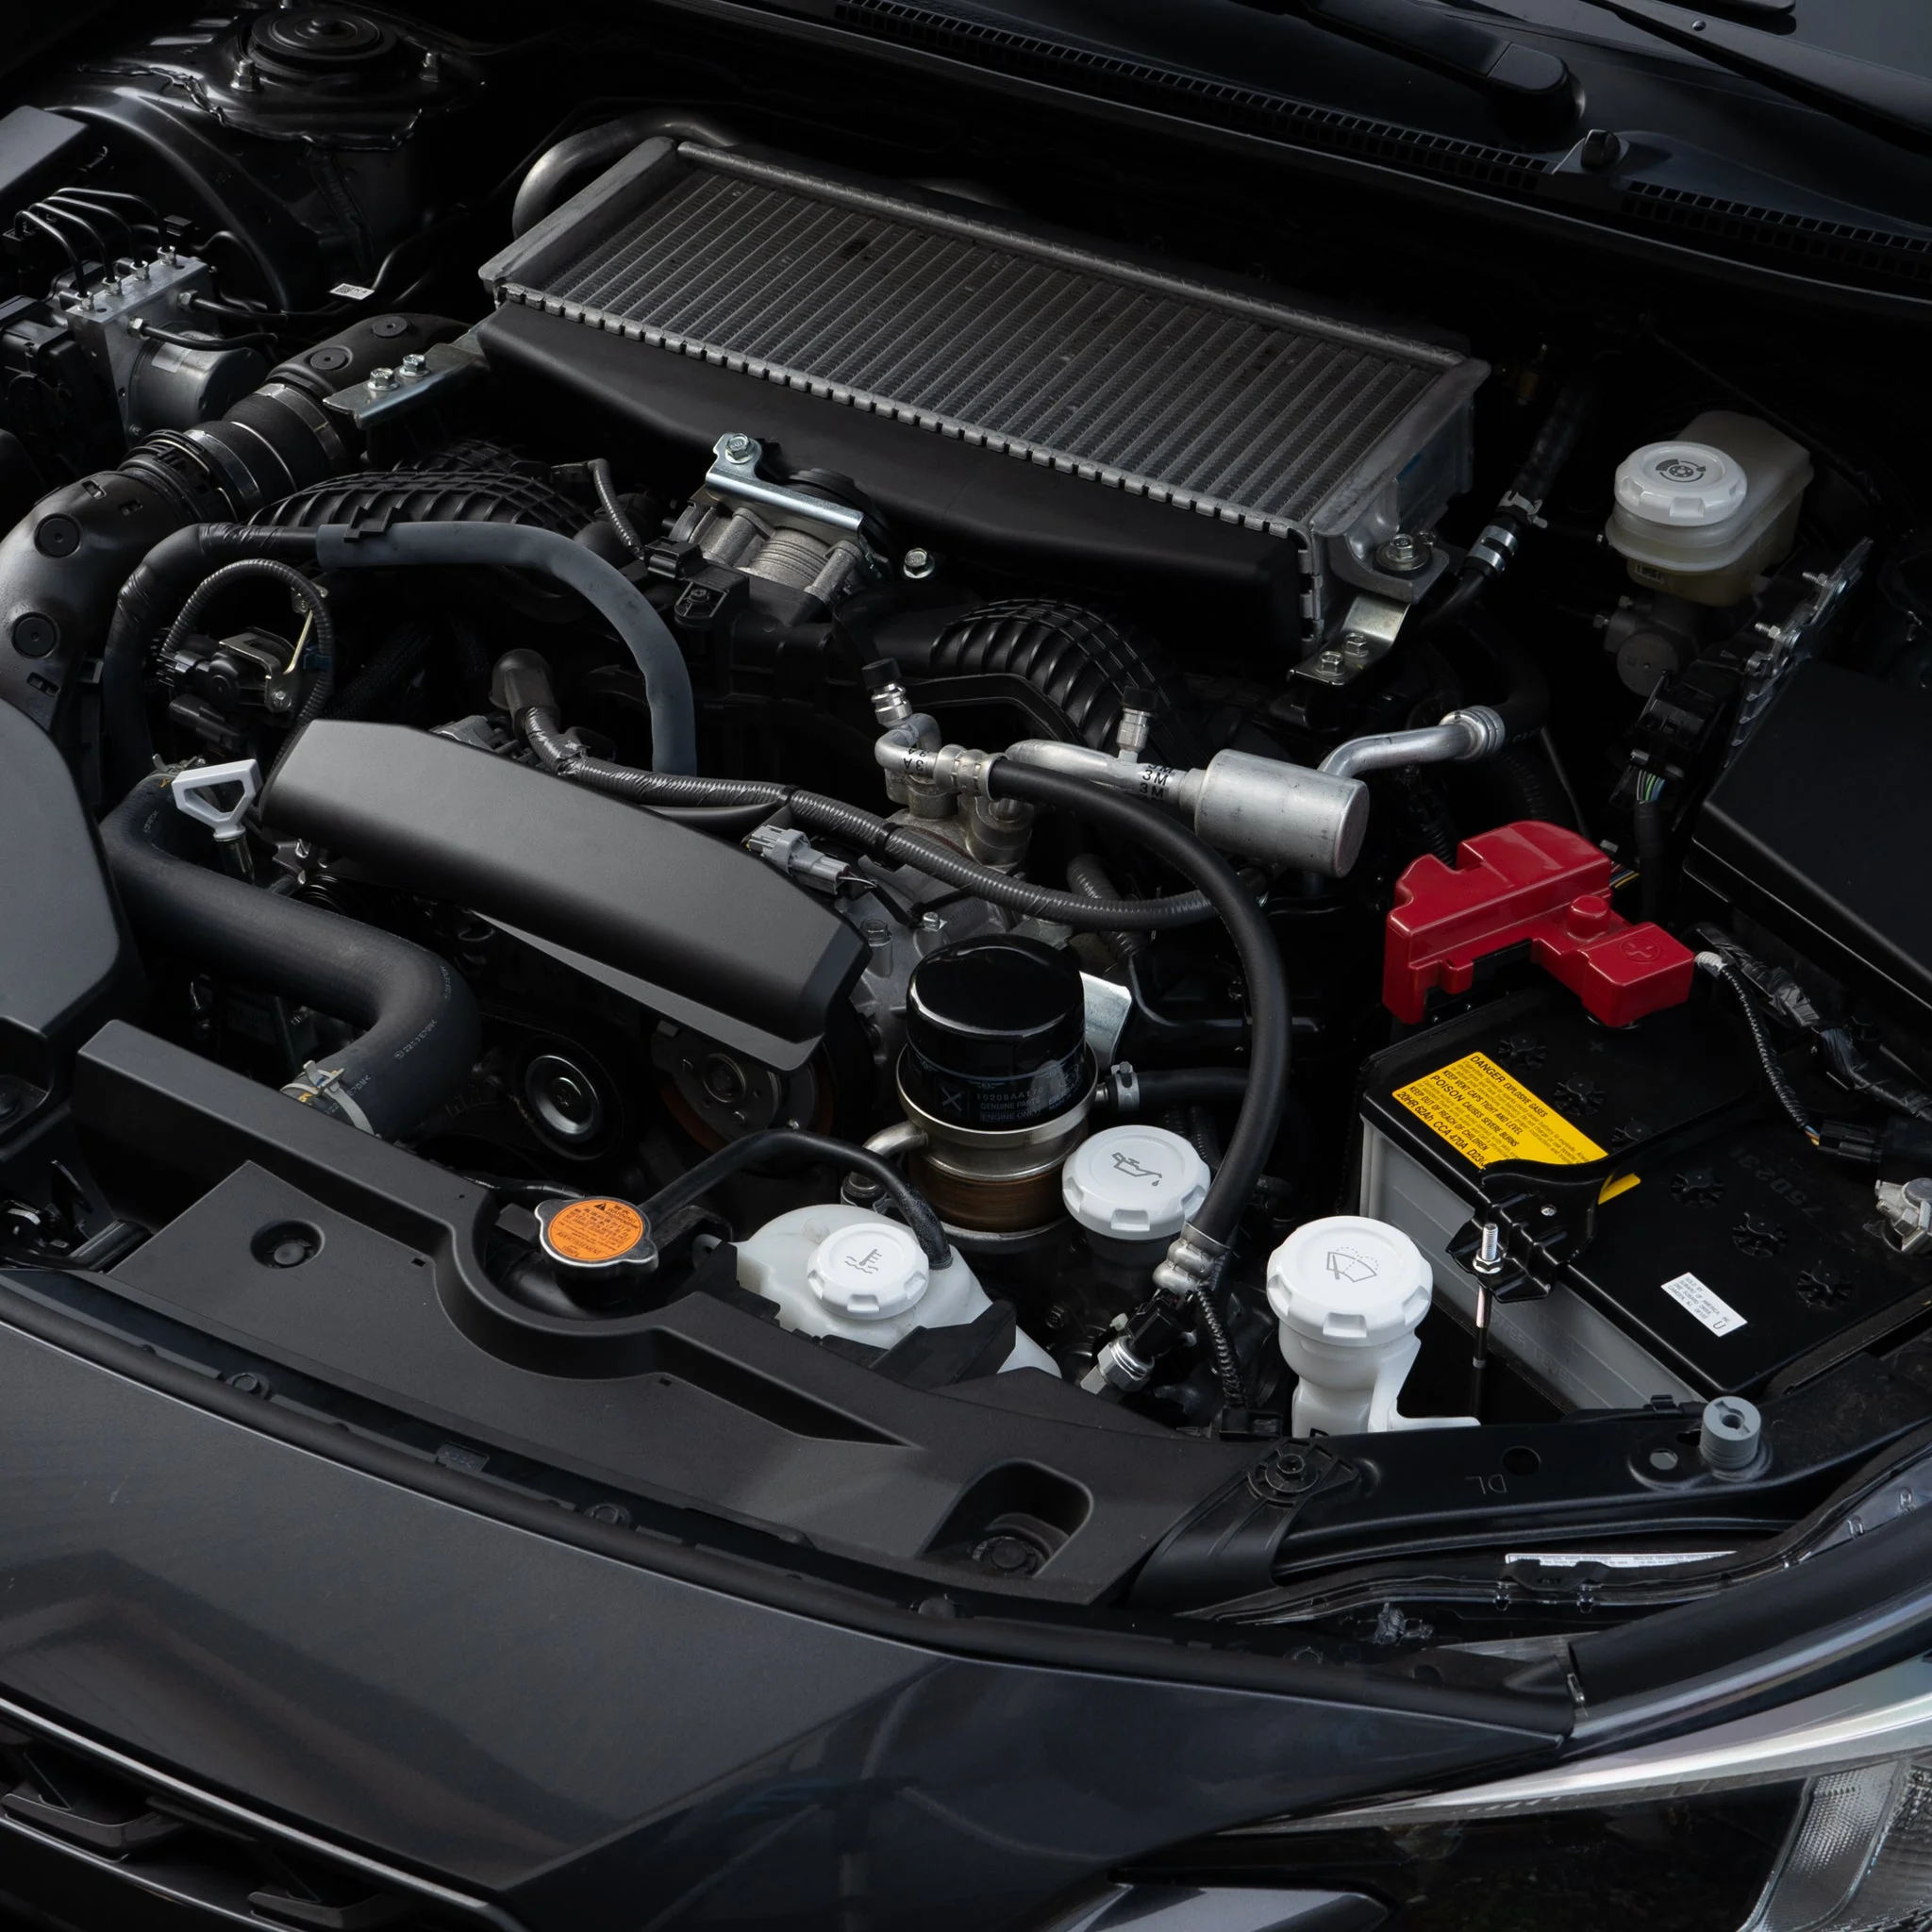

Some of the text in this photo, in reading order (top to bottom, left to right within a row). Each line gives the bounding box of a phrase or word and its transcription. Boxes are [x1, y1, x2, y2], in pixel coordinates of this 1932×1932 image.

[1140, 783, 1163, 798] 3M
[1142, 769, 1168, 786] 3M
[981, 1102, 1015, 1110] GENUINE
[1441, 1070, 1524, 1135] KEEP VENT CAPS TIGHT AND LEVEL
[1469, 1056, 1548, 1117] DANGER EXPLOSIVE GASES
[1395, 1091, 1420, 1108] 20HR
[1413, 1105, 1436, 1121] 62Ah
[1431, 1121, 1453, 1135] CCA
[1447, 1133, 1470, 1149] 470A
[1407, 1086, 1424, 1097] KEEP
[1420, 1095, 1434, 1106] OUT
[1437, 1109, 1458, 1124] REACH
[1460, 1129, 1490, 1151] CHILDREN
[1429, 1074, 1520, 1147] POISON CAUSES SEVERE BURNS
[1711, 1320, 1726, 1330] U
[1465, 1474, 1507, 1494] DL
